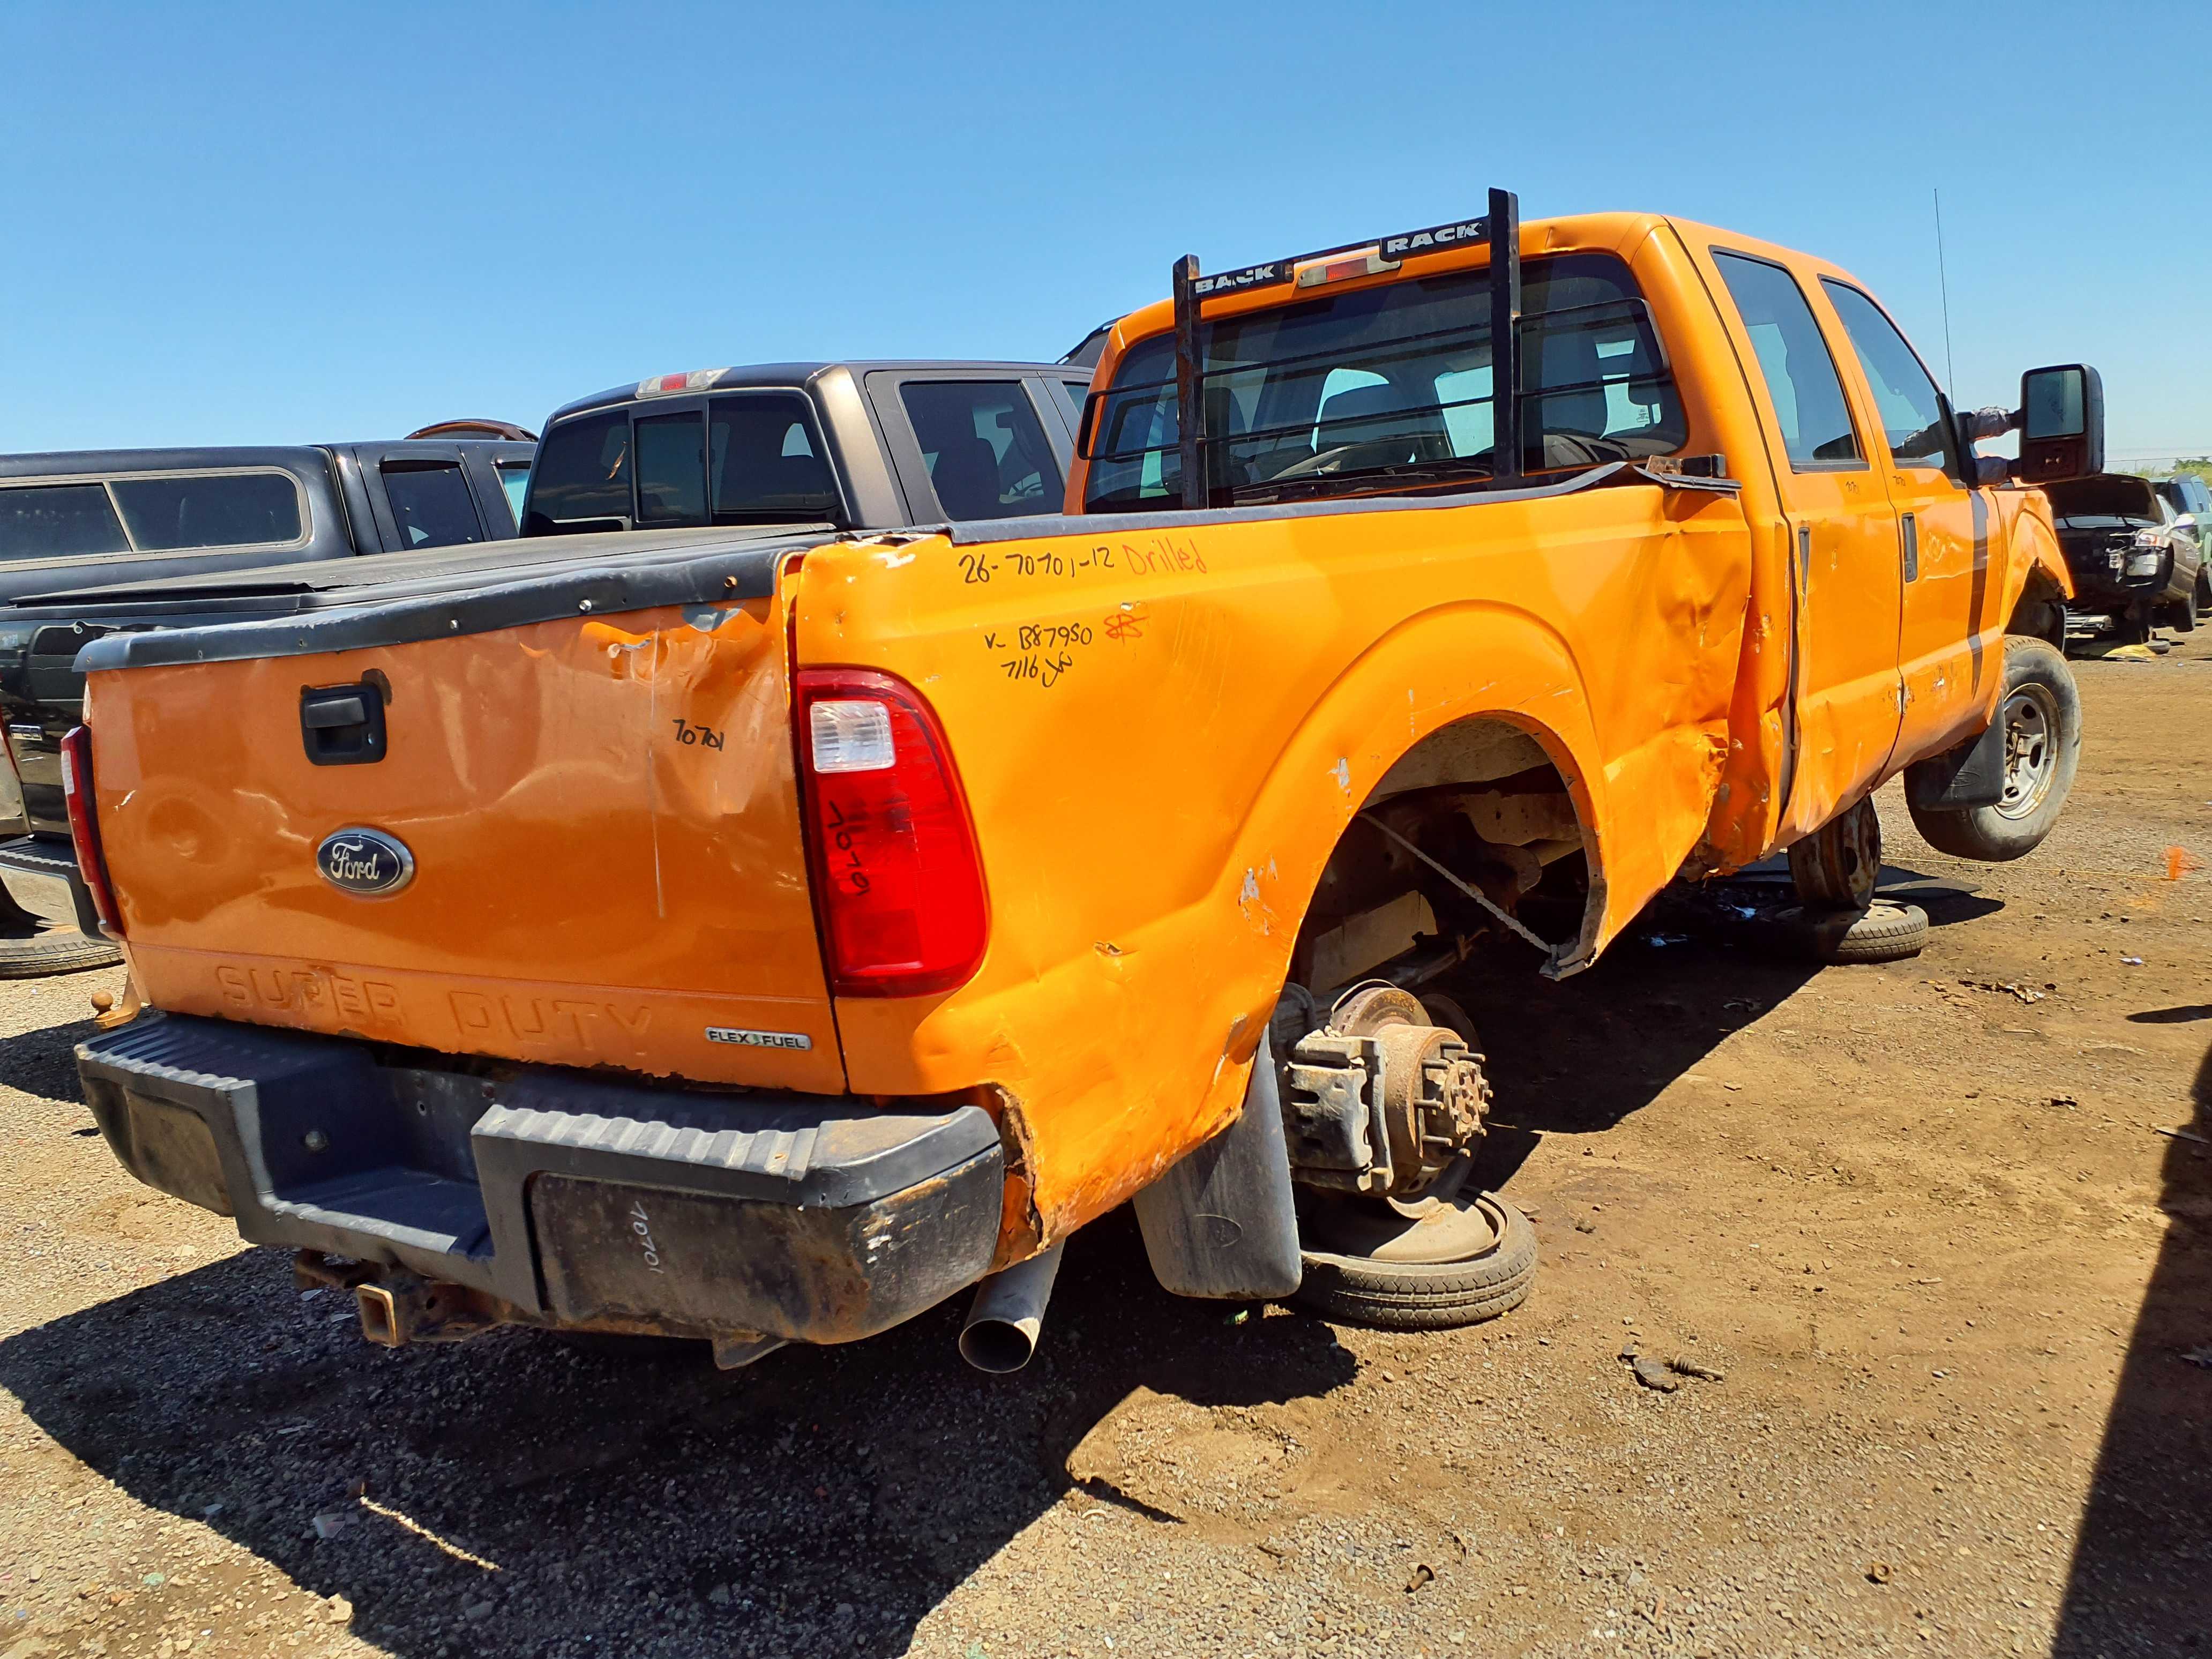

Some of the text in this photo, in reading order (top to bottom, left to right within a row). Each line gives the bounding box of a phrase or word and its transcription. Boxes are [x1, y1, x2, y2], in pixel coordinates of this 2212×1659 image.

[1195, 222, 1480, 294] BACK RACK
[1122, 539, 1207, 575] Drilled
[672, 719, 724, 752] 70701
[330, 841, 380, 880] Ford
[215, 966, 652, 1055] SUPER DUTY
[708, 1030, 806, 1049] FLEX FUEL
[630, 1200, 665, 1274] 70701
